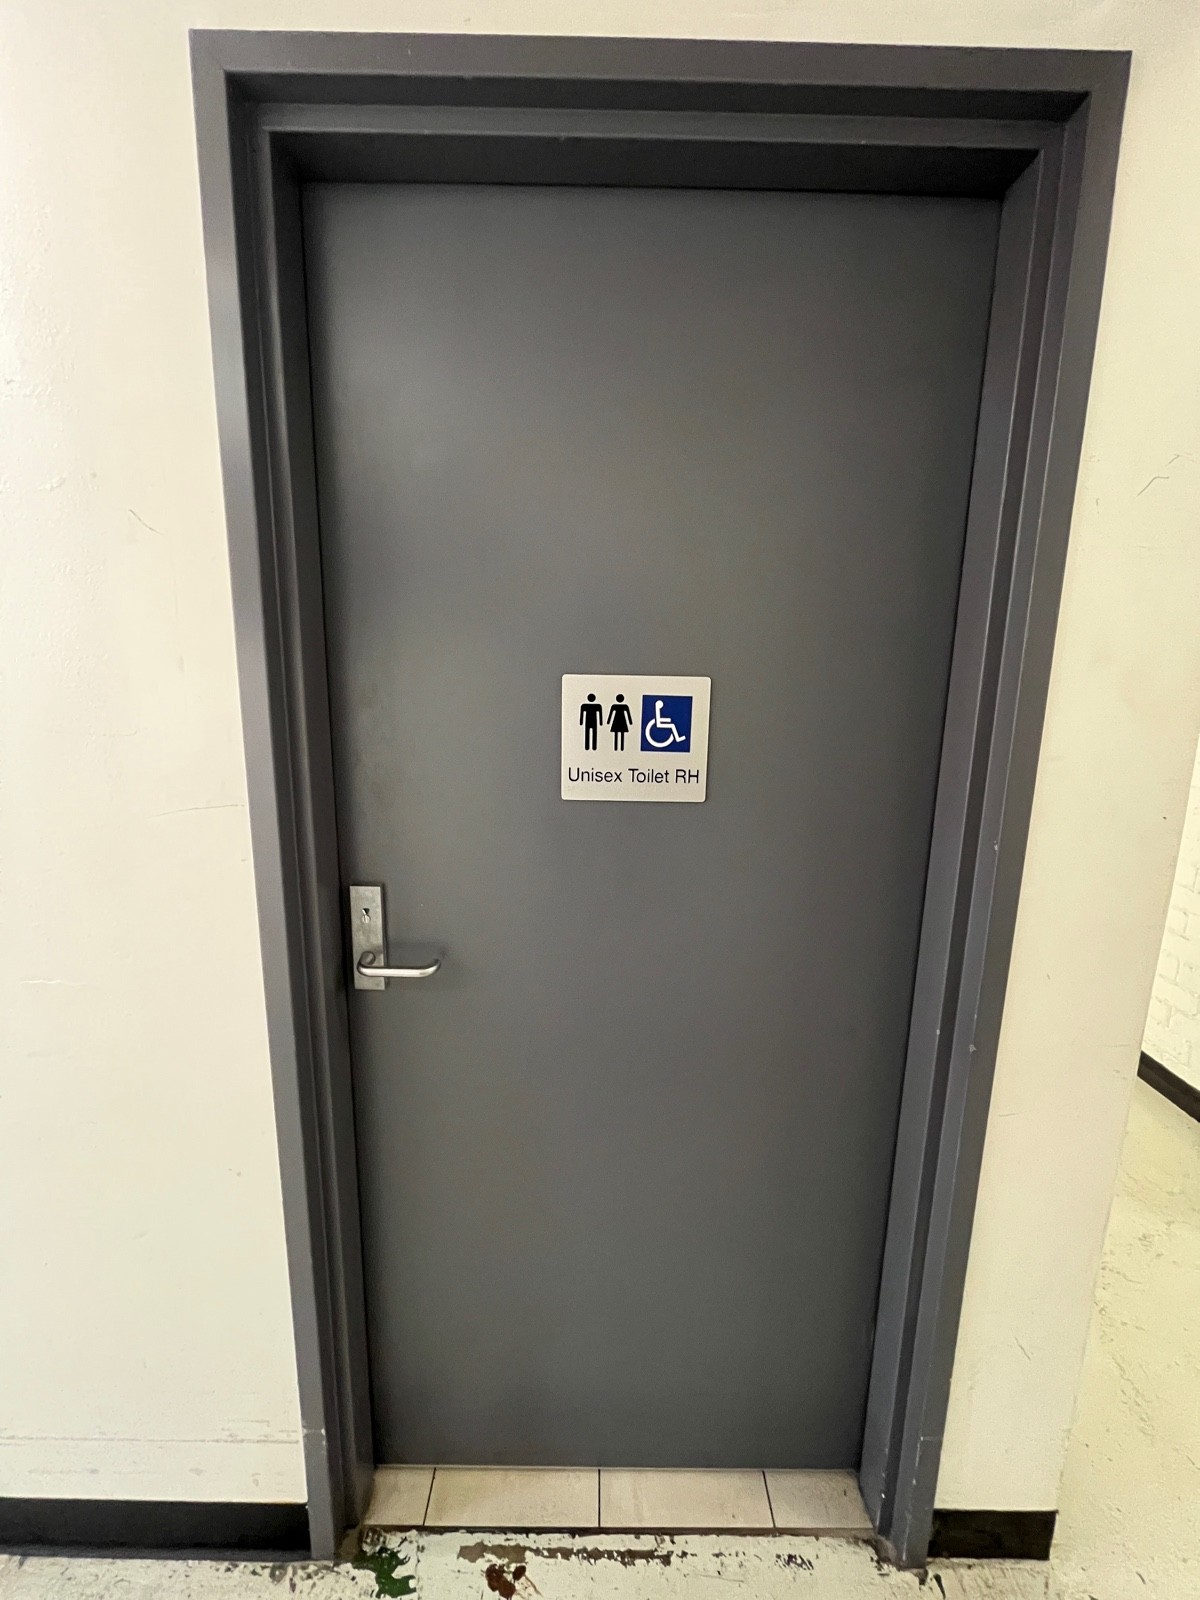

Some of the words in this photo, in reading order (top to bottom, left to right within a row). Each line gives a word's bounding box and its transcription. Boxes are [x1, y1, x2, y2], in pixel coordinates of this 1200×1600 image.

[568, 766, 622, 783] Unisex
[628, 767, 670, 784] Toilet
[676, 768, 699, 784] RH
